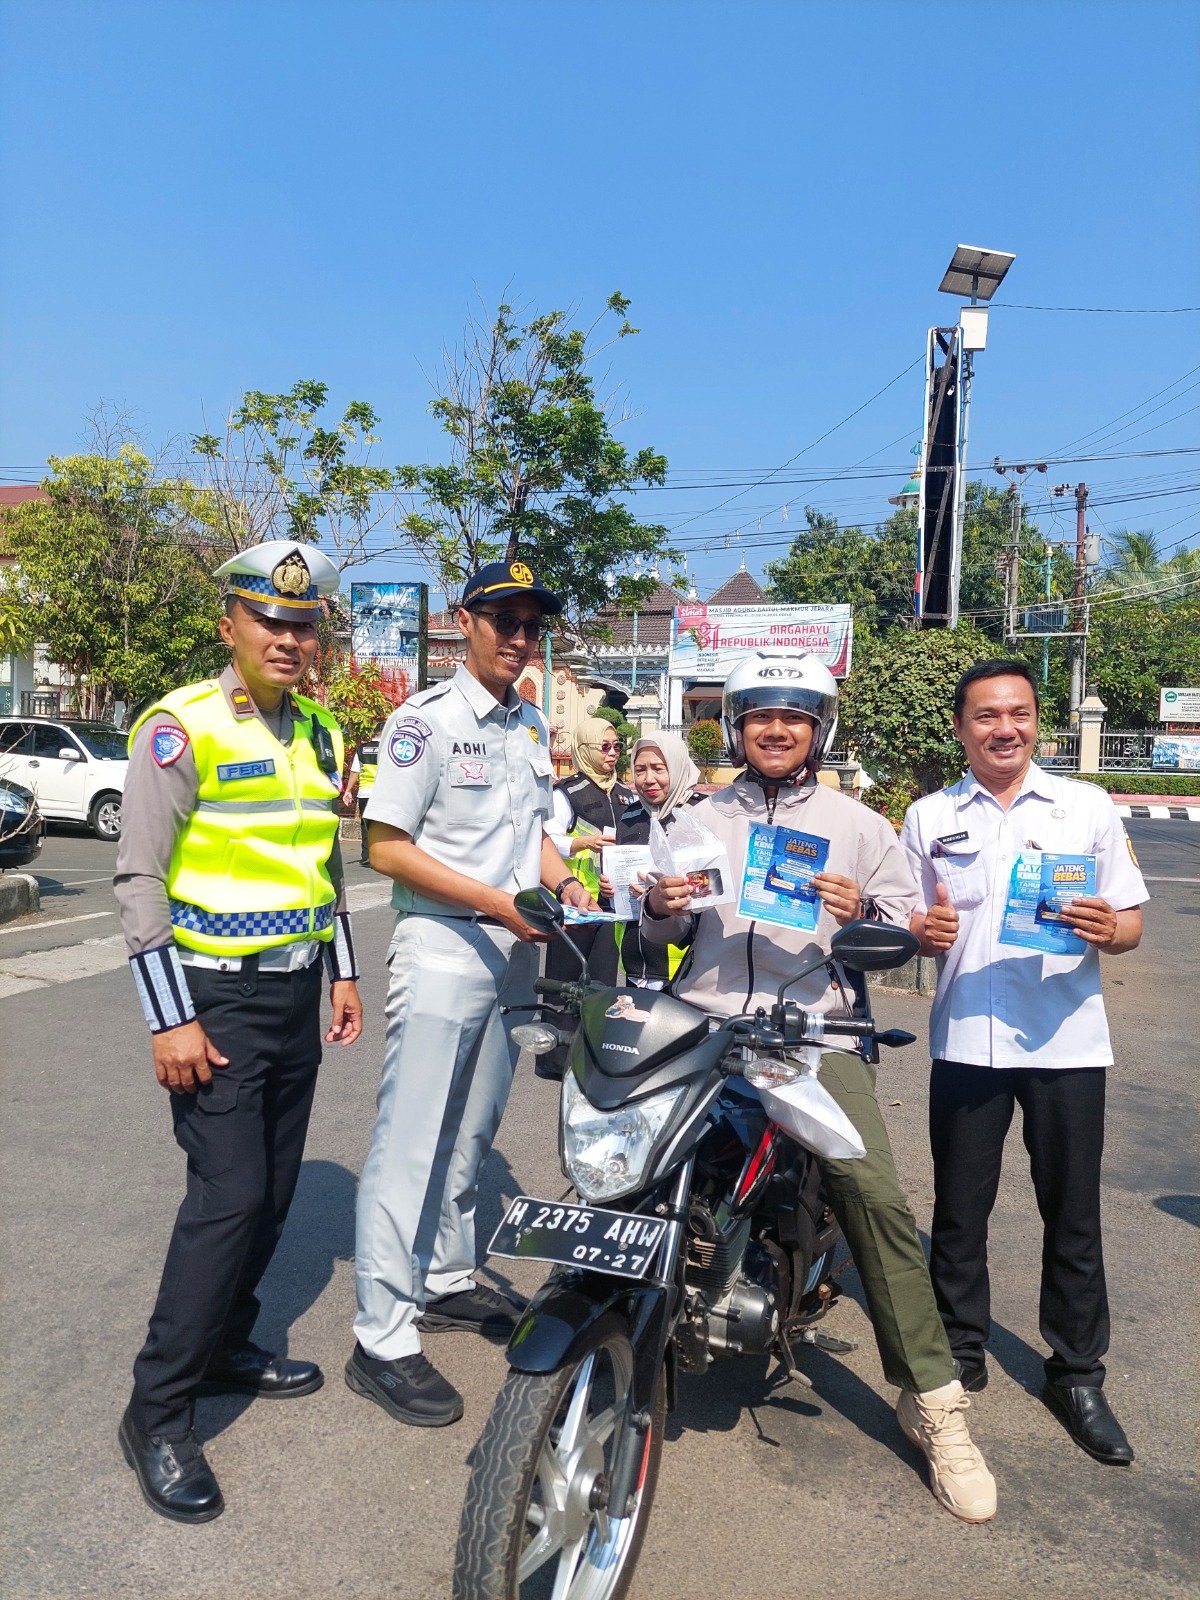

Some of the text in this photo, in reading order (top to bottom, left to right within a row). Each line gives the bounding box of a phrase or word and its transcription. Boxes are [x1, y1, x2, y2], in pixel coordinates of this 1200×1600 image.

[769, 624, 830, 635] DIRGAHAYU
[720, 637, 830, 647] REPUBLIK INDONESIA
[452, 742, 487, 755] ADHI
[226, 762, 268, 778] FERI
[787, 838, 817, 849] JATENG
[785, 843, 818, 857] BEBAS
[1053, 864, 1085, 873] JATENG
[1053, 872, 1086, 882] BEBAS
[601, 1042, 640, 1056] HONDA
[507, 1201, 660, 1247] H 2375 AHW
